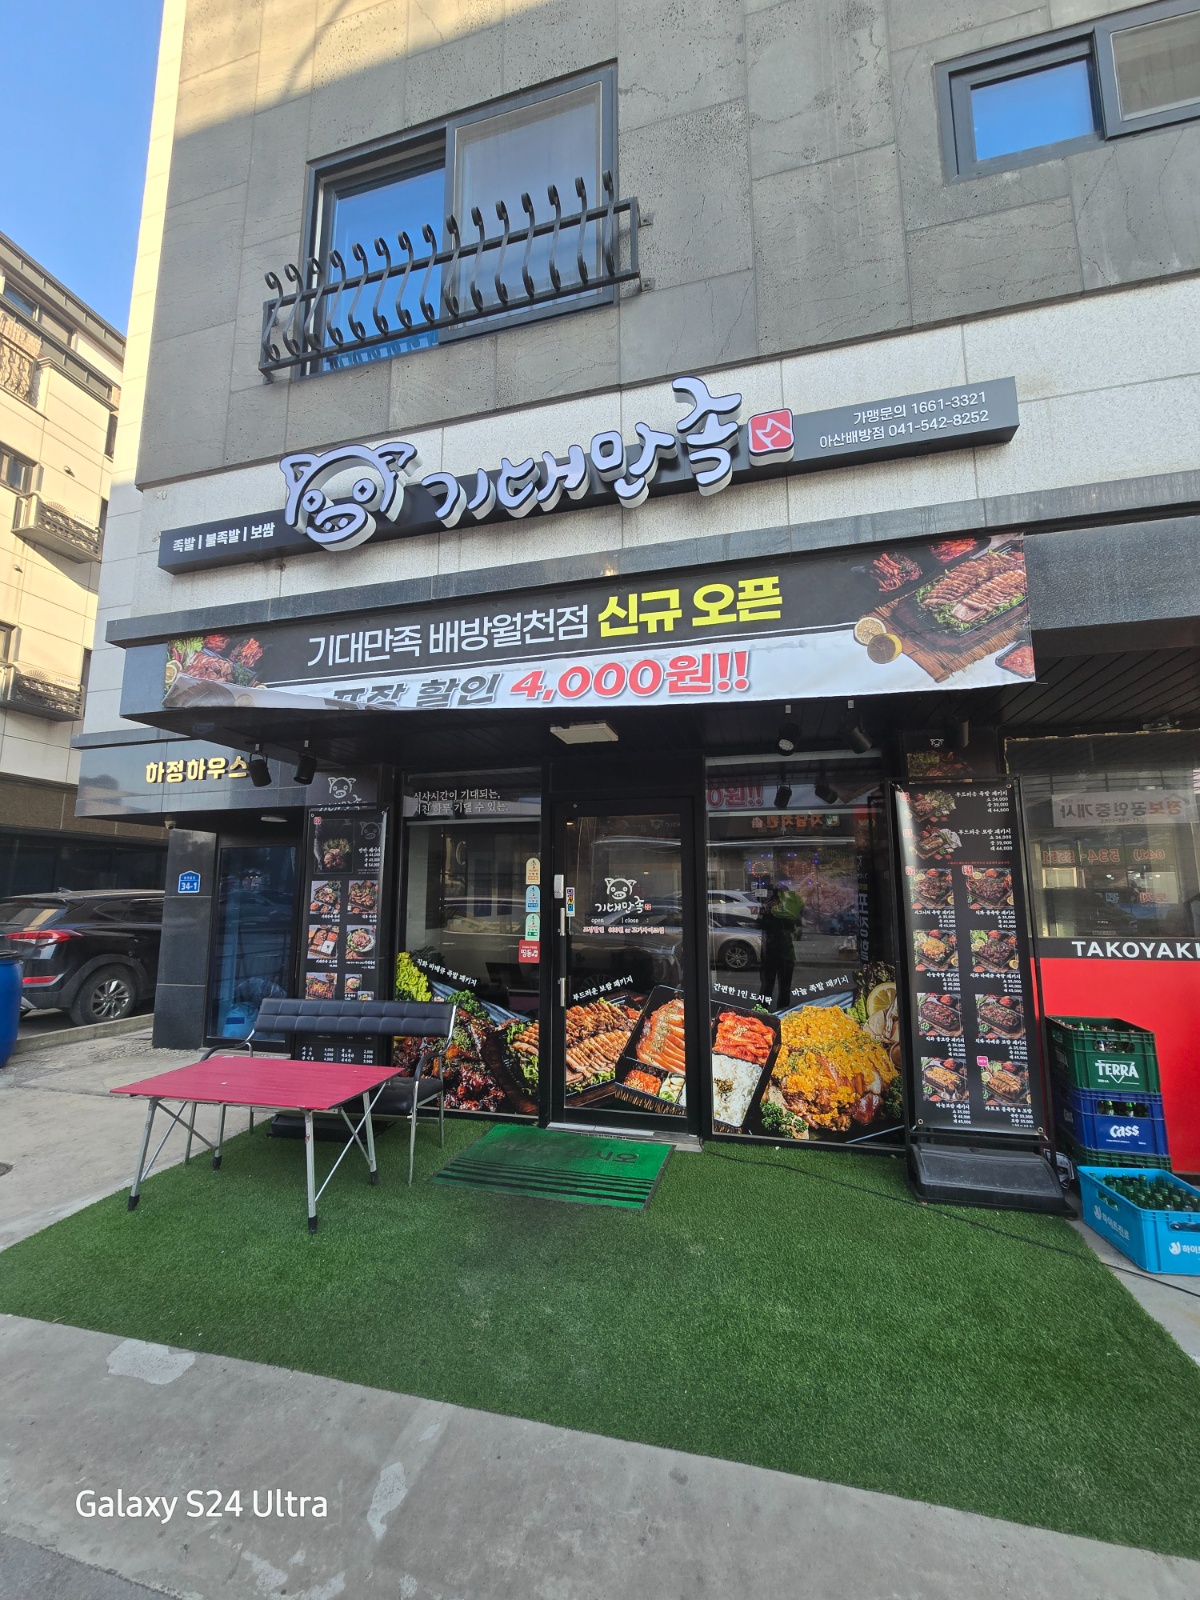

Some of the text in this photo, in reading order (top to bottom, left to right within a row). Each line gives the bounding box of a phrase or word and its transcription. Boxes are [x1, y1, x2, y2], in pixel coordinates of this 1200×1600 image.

[853, 391, 987, 425] 가맹문의 1661-3321
[819, 409, 990, 448] 아산배방점 041-542-8252
[421, 376, 742, 505] 기대만족
[173, 522, 275, 553] 족발 불족발 보쌈
[307, 576, 783, 667] 기대만족 배방월천점 신규 오픈
[416, 673, 499, 707] 할인
[510, 650, 751, 701] 4,000원!!
[145, 756, 248, 783] 하정하우스
[461, 788, 501, 799] 기대되는,
[433, 802, 452, 814] 하루
[454, 801, 472, 814] 기댈
[475, 802, 485, 813] 수
[181, 882, 198, 891] 34-1
[594, 895, 645, 914] 기대만족
[1072, 941, 1200, 959] TAKOYAKI
[459, 974, 478, 987] 패키지
[573, 987, 599, 1001] 부드러운
[613, 975, 634, 987] 패키지
[791, 974, 849, 997] 마늘 족발 패키지
[714, 983, 773, 1006] 간편한 1인 도시락
[1095, 1061, 1139, 1078] TERRA
[1110, 1125, 1139, 1138] Cass
[1102, 1212, 1130, 1241] 하이트진로
